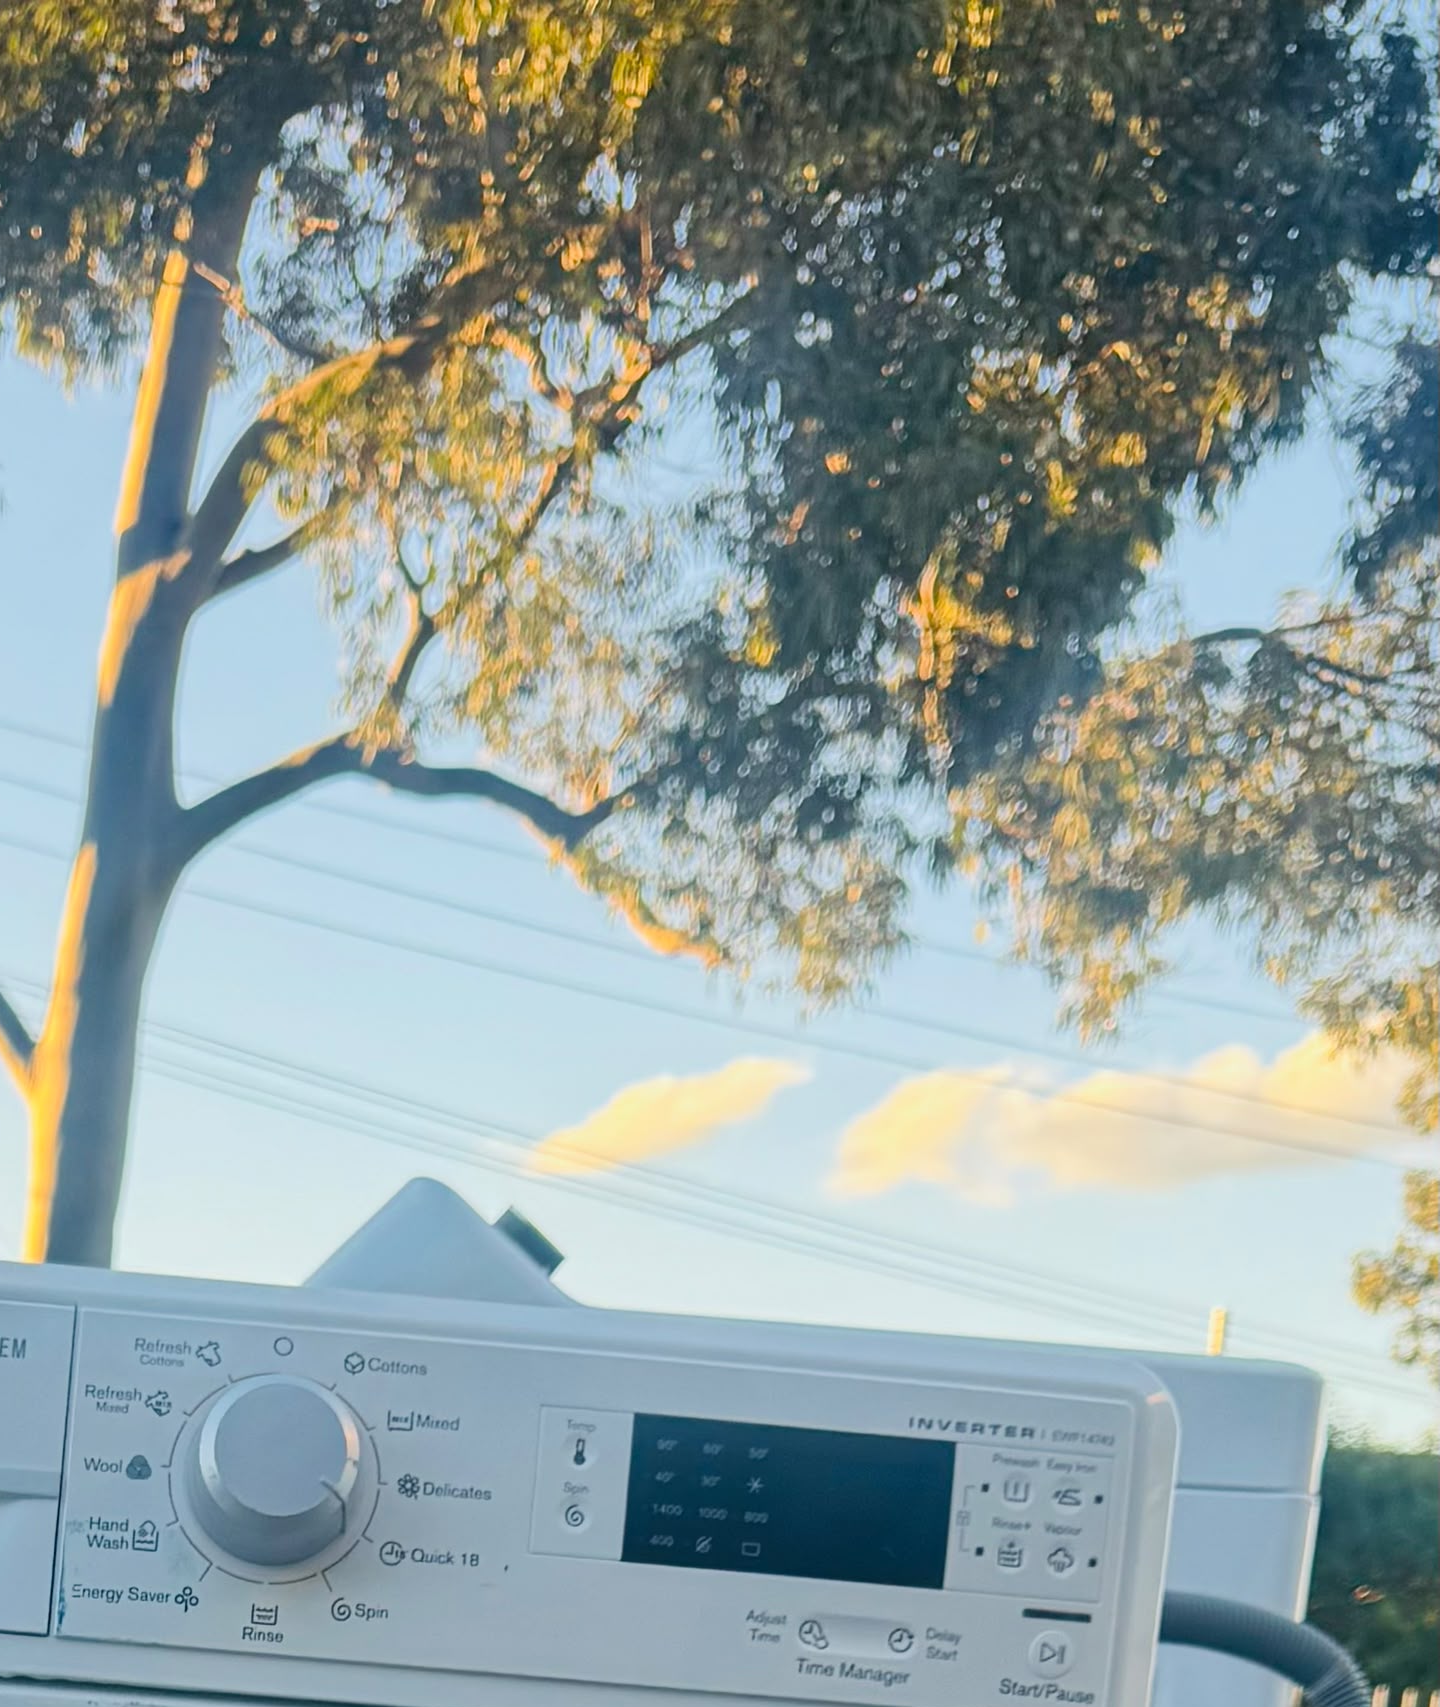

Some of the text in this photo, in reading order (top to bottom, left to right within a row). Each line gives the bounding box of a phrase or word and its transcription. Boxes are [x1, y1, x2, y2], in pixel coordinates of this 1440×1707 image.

[134, 1337, 192, 1355] Refresh
[139, 1354, 185, 1367] Cottons
[368, 1357, 427, 1376] Cottons
[85, 1384, 142, 1401] Refresh
[96, 1402, 129, 1414] Mixed
[416, 1414, 460, 1431] Mixed
[909, 1416, 1036, 1439] INVERTER
[84, 1457, 122, 1473] Wool
[423, 1481, 492, 1501] Delicates
[89, 1516, 129, 1533] Hand
[86, 1534, 129, 1550] Wash
[411, 1548, 455, 1565] Quick
[460, 1552, 480, 1567] 18
[71, 1583, 171, 1604] Energy Saver
[354, 1603, 389, 1621] Spin
[746, 1609, 788, 1627] Adjust
[242, 1626, 284, 1643] Rinse
[749, 1628, 781, 1644] Time
[925, 1627, 962, 1646] Delay
[926, 1646, 959, 1662] Start
[796, 1657, 911, 1687] Time Manager
[999, 1677, 1095, 1705] Start/Pause
